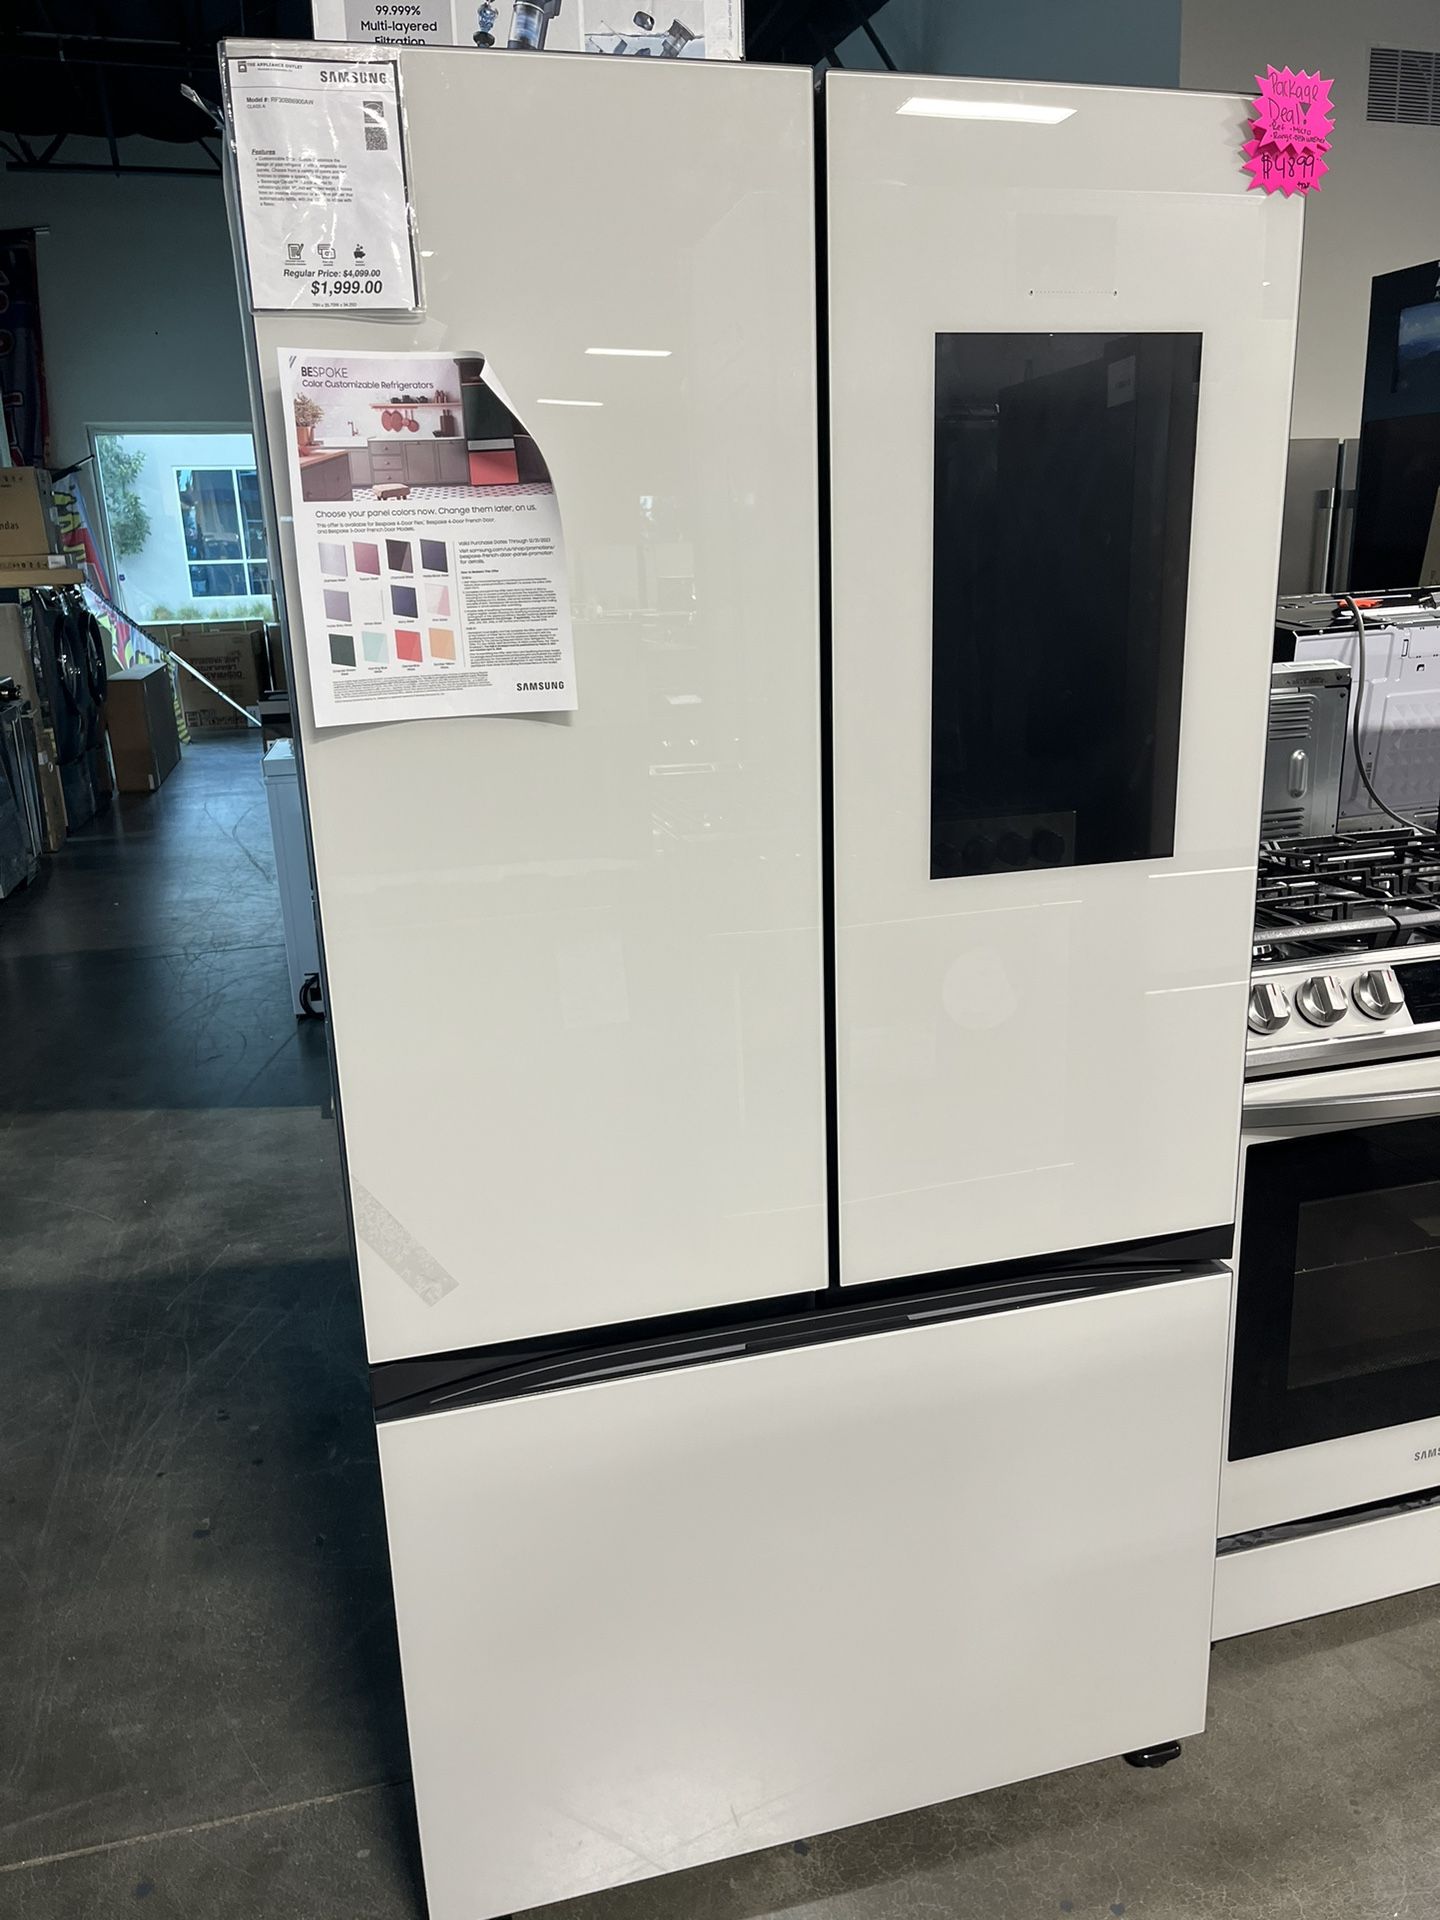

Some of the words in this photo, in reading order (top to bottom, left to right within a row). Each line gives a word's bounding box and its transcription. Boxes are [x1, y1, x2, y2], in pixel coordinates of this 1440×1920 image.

[375, 5, 421, 16] 99.999%
[360, 20, 438, 34] Multi-layered
[374, 36, 426, 45] Filtration
[320, 71, 387, 84] SAMSUNG
[1268, 72, 1319, 103] Package
[283, 269, 316, 279] Regular
[317, 269, 341, 278] Price:
[343, 269, 381, 278] $4,099.00
[311, 280, 383, 296] $1,999.00
[301, 366, 349, 378] BESPOKE
[302, 379, 324, 388] Color
[324, 380, 380, 389] Customizable
[380, 381, 434, 391] Refrigerators
[315, 510, 347, 518] Choose
[347, 510, 366, 519] your
[367, 508, 391, 518] panel
[391, 508, 416, 516] colors
[438, 506, 471, 516] Change
[471, 504, 494, 513] them
[515, 504, 526, 512] on
[516, 681, 565, 691] SAMSUNG
